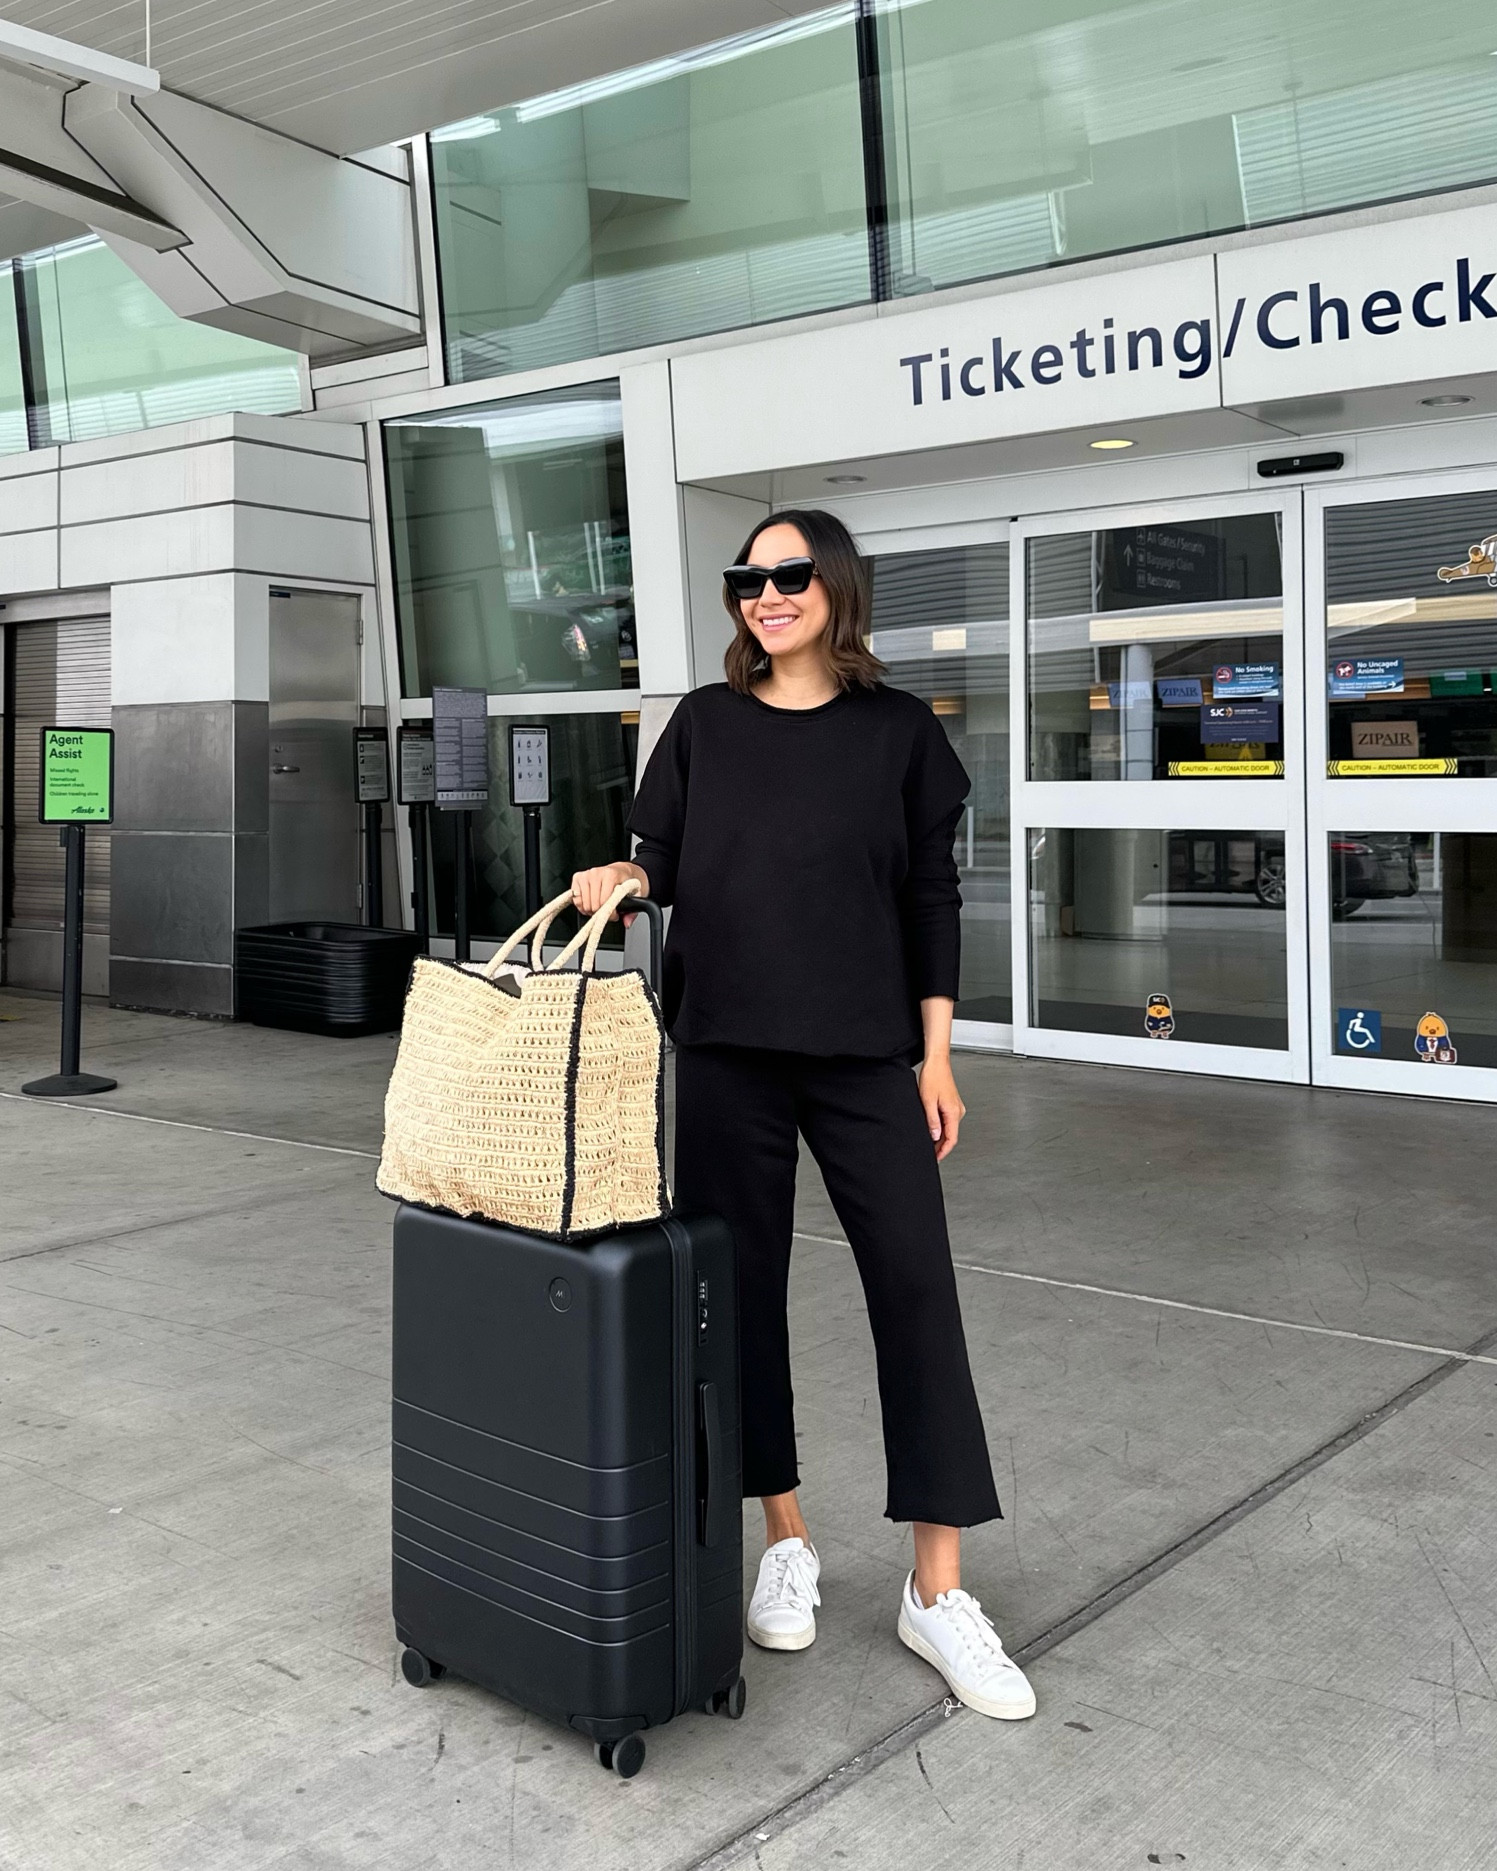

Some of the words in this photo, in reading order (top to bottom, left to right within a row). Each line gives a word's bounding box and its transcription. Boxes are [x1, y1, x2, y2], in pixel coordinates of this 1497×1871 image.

[1147, 551, 1176, 571] Baggage
[1176, 557, 1195, 572] Claim
[1147, 573, 1181, 590] Restrooms
[1246, 666, 1274, 674] Smoking
[1368, 660, 1398, 668] Uncaged
[1161, 686, 1199, 698] ZIPAIR
[1210, 708, 1225, 717] SJC
[49, 734, 83, 746] Agent
[1358, 733, 1412, 747] ZIPAIR
[49, 748, 82, 759] Assist
